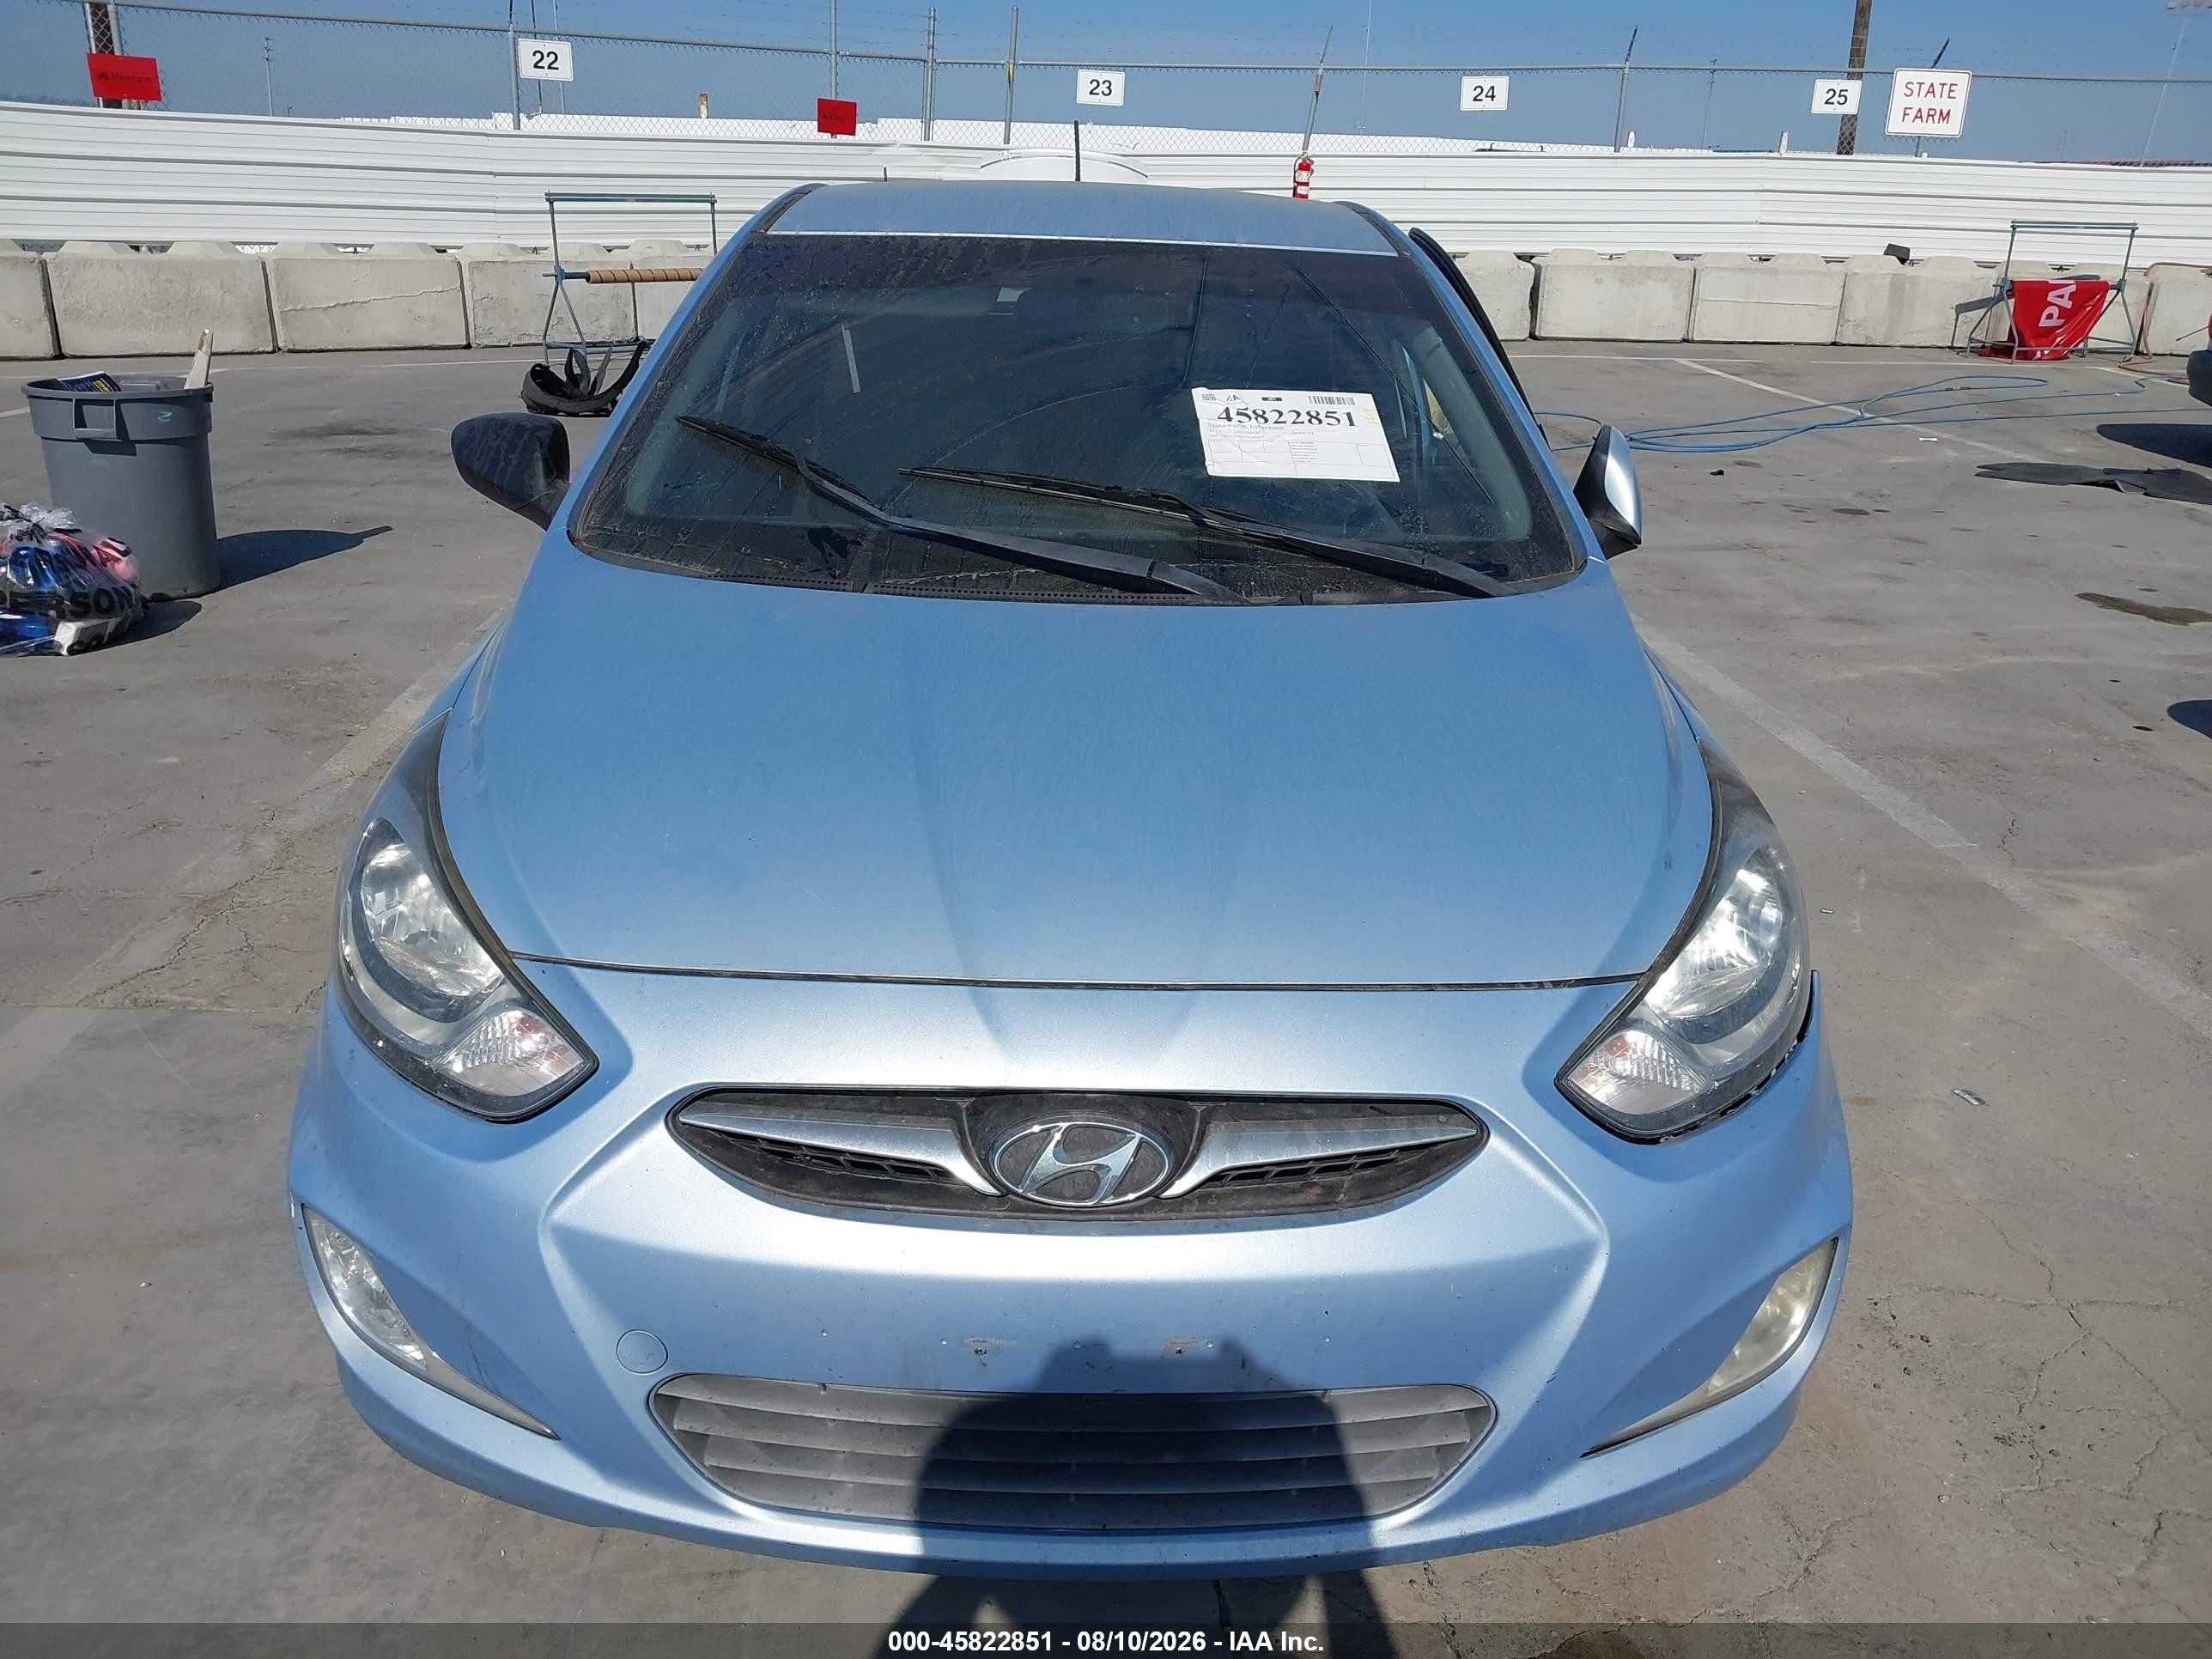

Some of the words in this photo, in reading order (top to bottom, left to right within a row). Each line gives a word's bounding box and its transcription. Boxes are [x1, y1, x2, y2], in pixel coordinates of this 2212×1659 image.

[532, 50, 559, 70] 22
[1089, 79, 1112, 96] 23
[1473, 85, 1496, 101] 24
[1904, 82, 1959, 100] STATE
[1824, 88, 1849, 106] 25
[1901, 107, 1952, 125] FARM
[1217, 406, 1359, 428] 45822851
